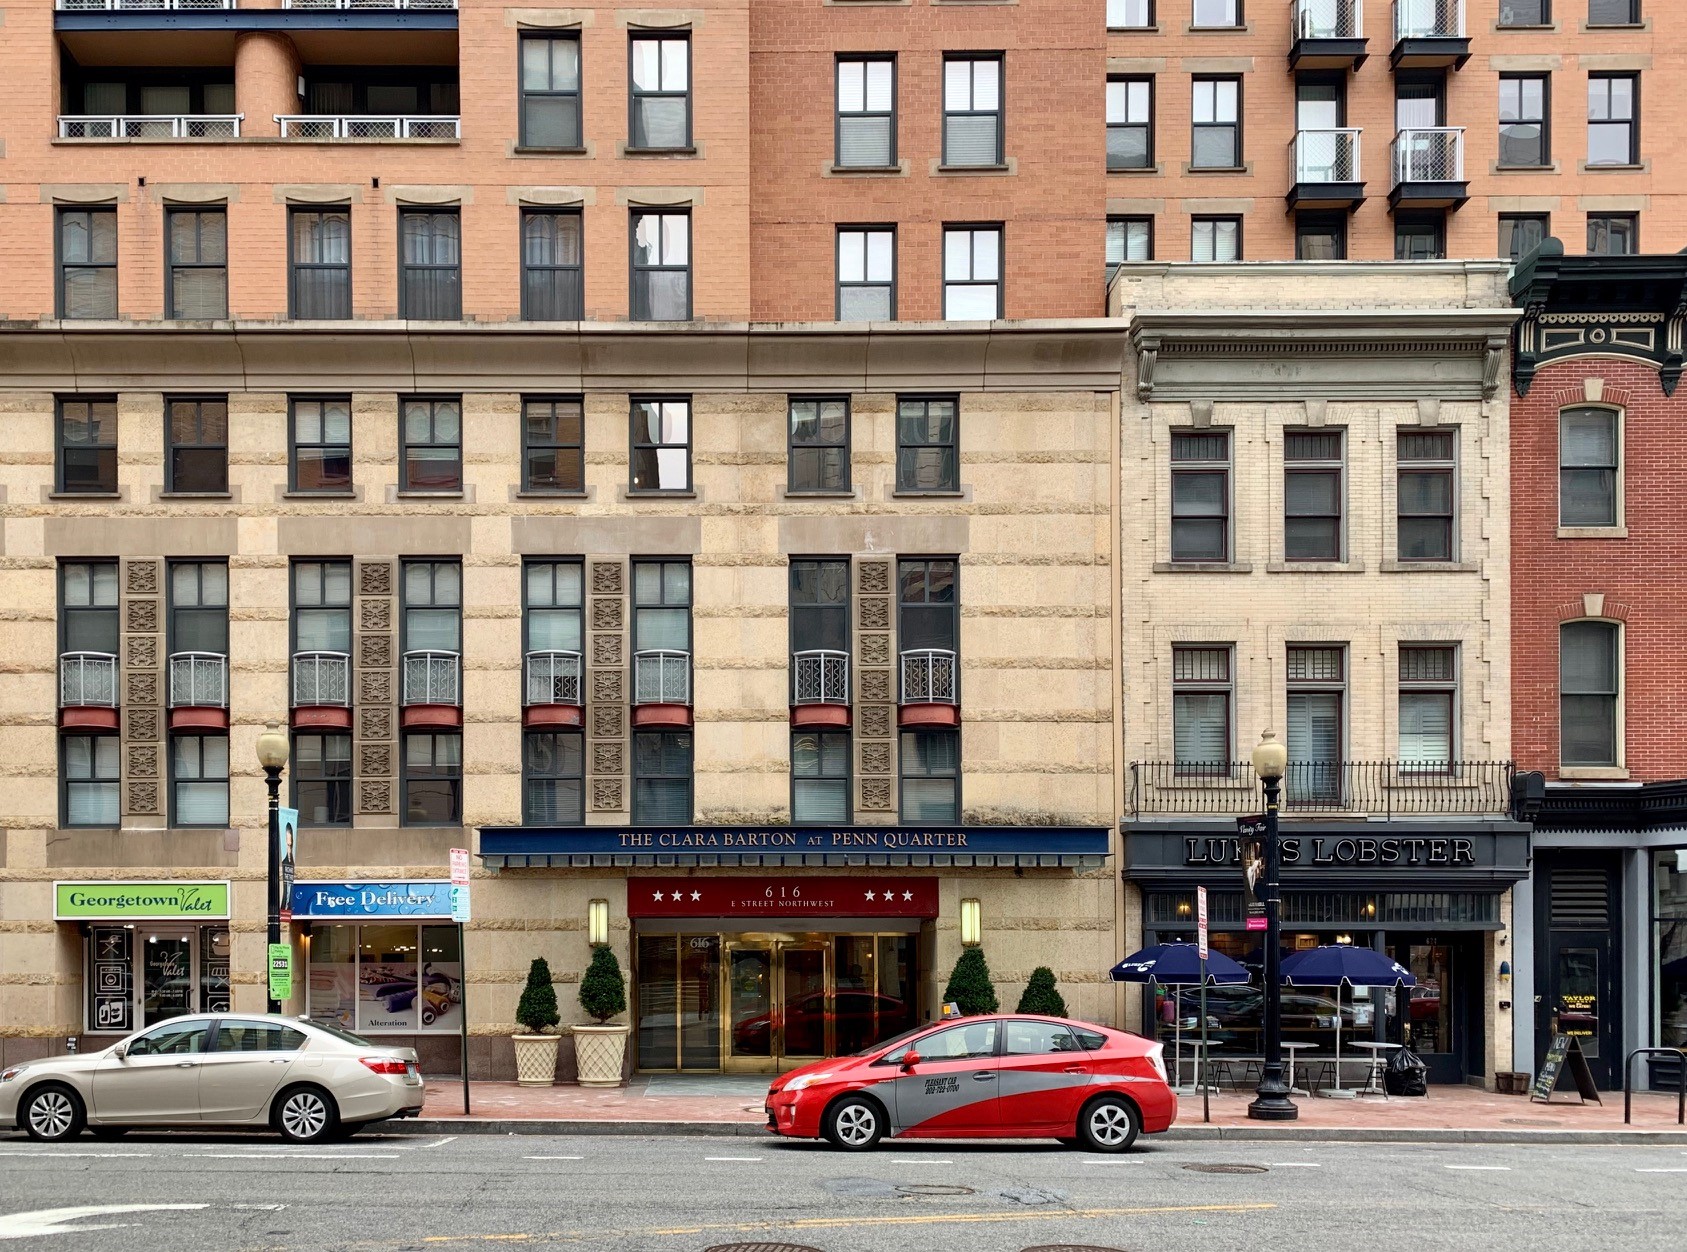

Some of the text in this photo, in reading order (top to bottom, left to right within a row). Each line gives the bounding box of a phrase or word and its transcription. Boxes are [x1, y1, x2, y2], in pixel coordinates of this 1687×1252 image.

[618, 832, 968, 849] THE CLARA BARTON AT PENN QUARTER
[1314, 838, 1475, 863] LOBSTER
[69, 887, 212, 912] Georgetown Valet
[316, 891, 436, 908] Free Delivery
[690, 937, 710, 949] 616
[160, 951, 185, 976] Valet
[368, 1019, 408, 1027] Alteration
[925, 1076, 958, 1088] PLEASANT CAB
